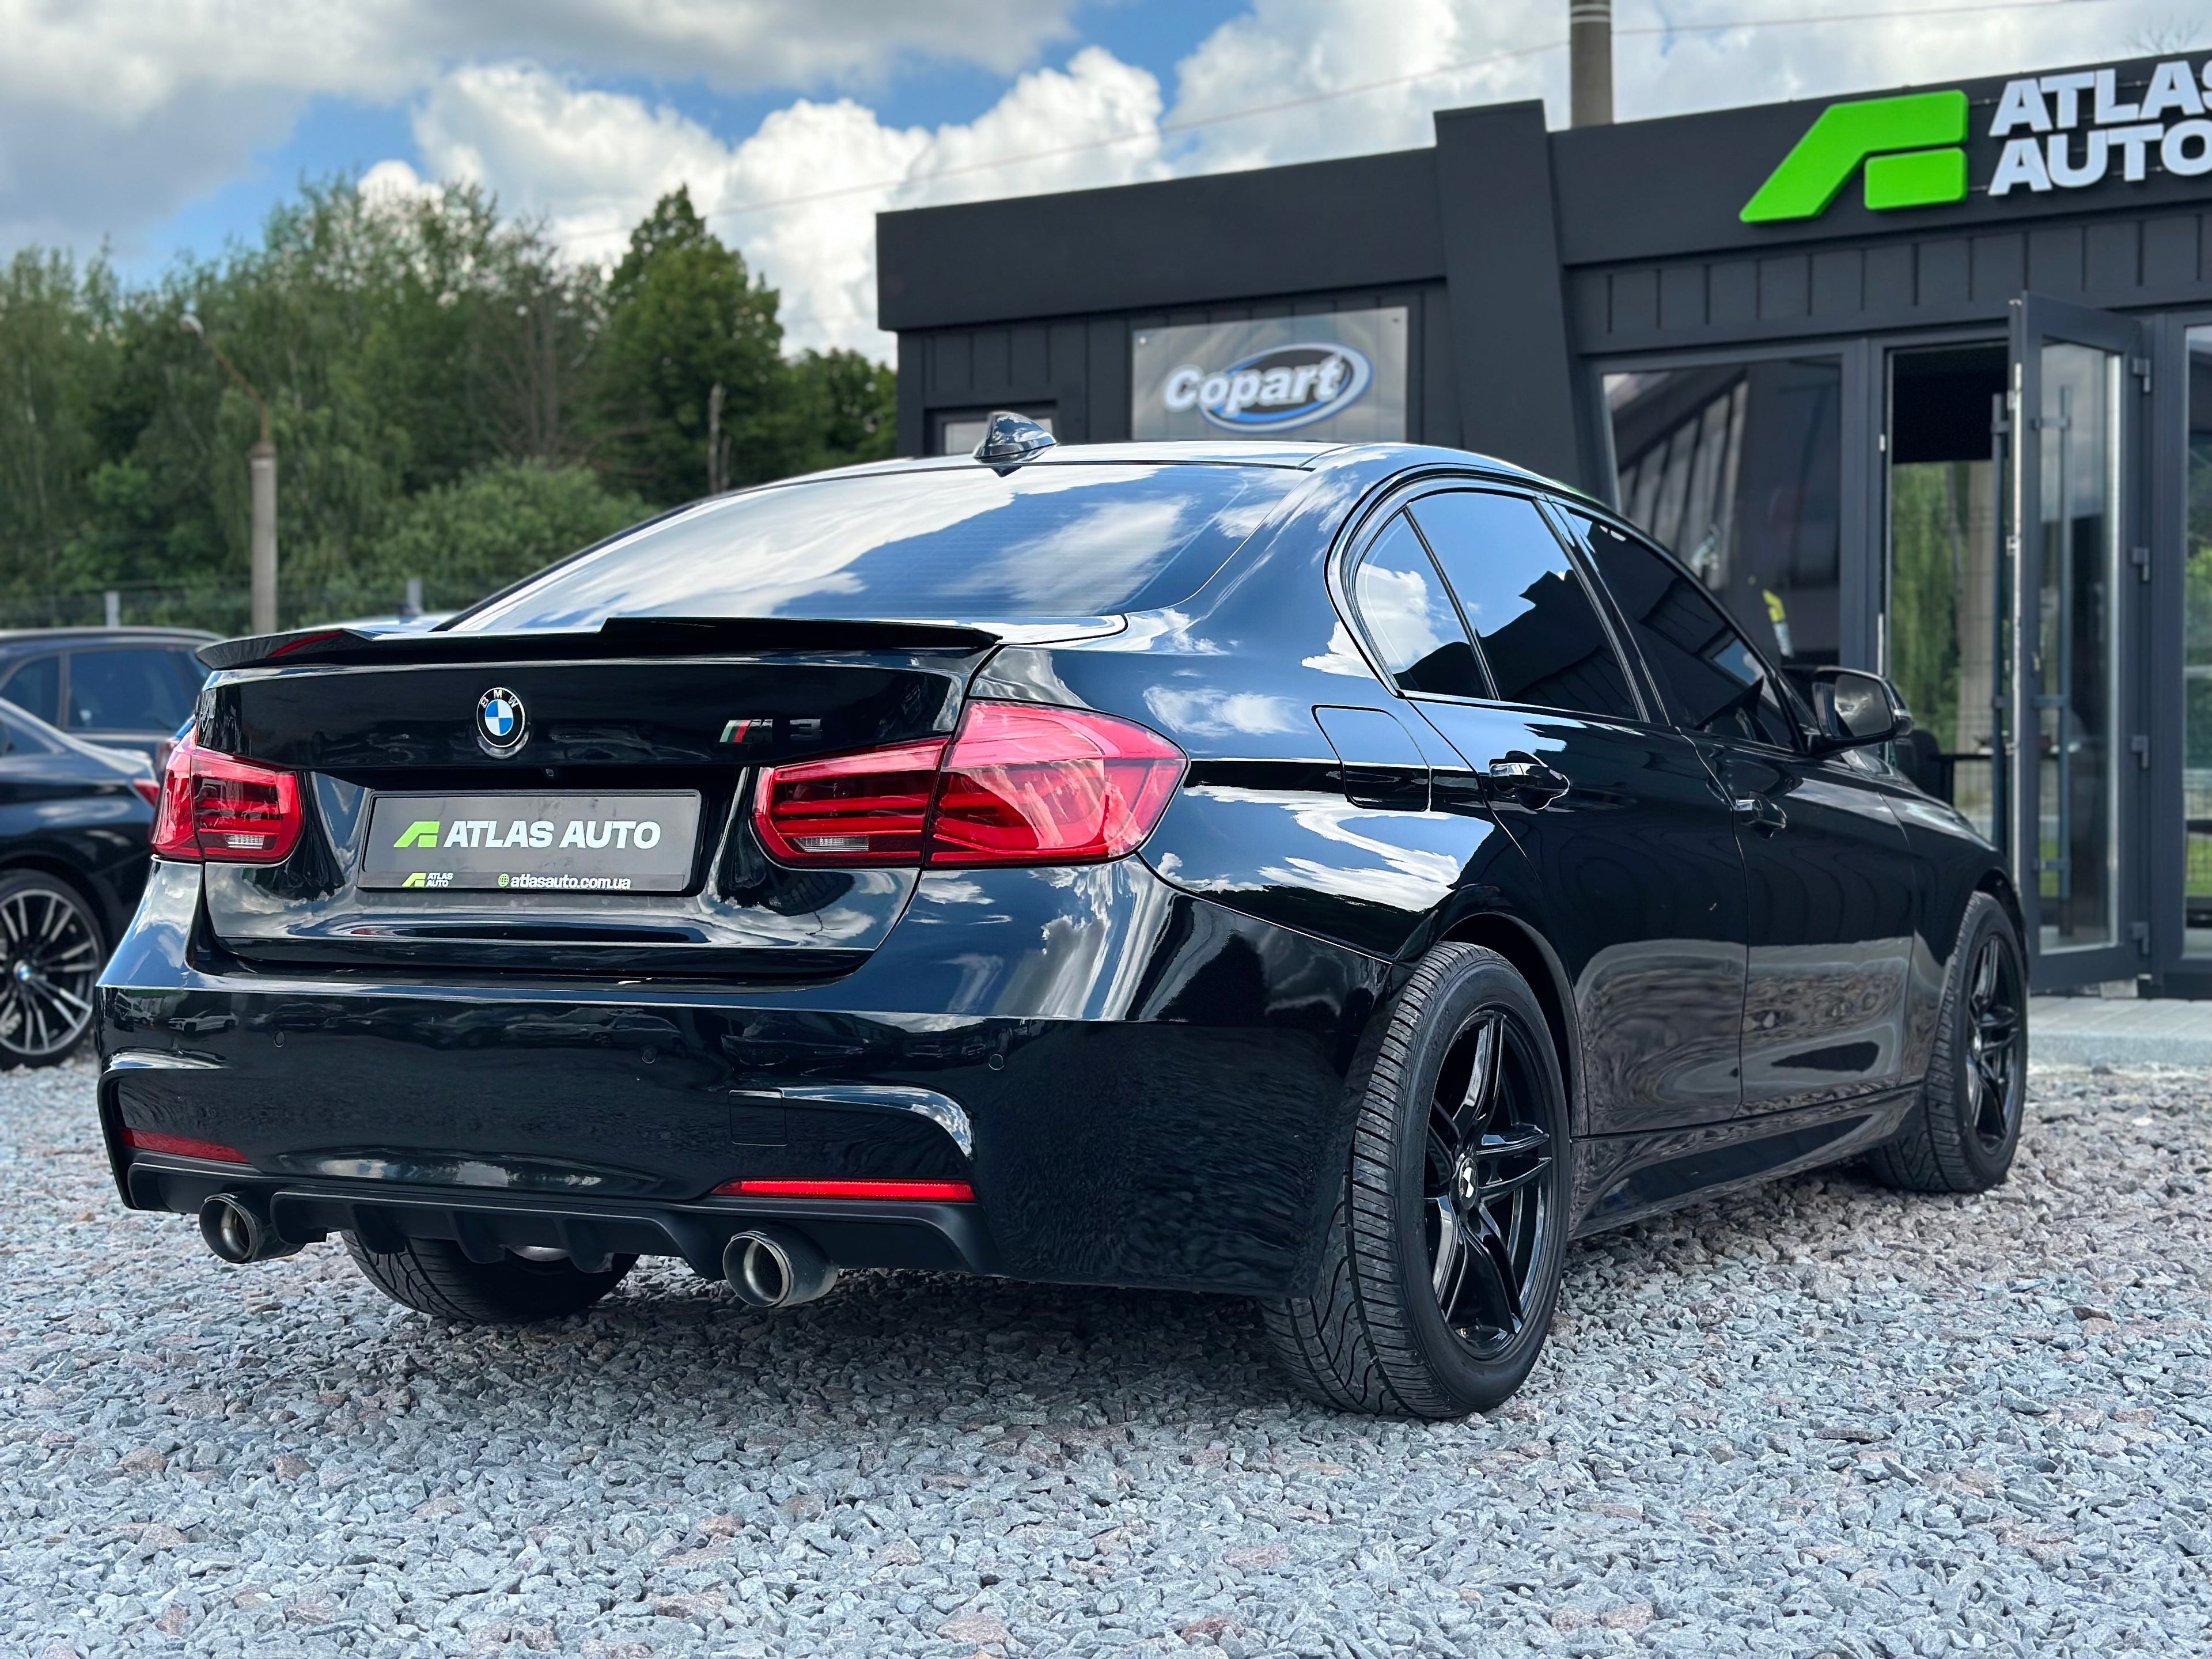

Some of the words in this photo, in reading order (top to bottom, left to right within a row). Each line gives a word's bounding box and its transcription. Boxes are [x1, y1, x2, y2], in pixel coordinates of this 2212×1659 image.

[1988, 60, 2212, 137] ATLA
[1987, 119, 2212, 196] AUTO
[1164, 353, 1344, 416] Copart
[480, 689, 519, 709] BMW
[443, 821, 554, 848] ATLAS
[559, 821, 661, 849] AUTO
[426, 880, 449, 888] AUTO
[427, 872, 453, 880] ATLAS
[510, 873, 631, 889] atlasauto.com.ua
